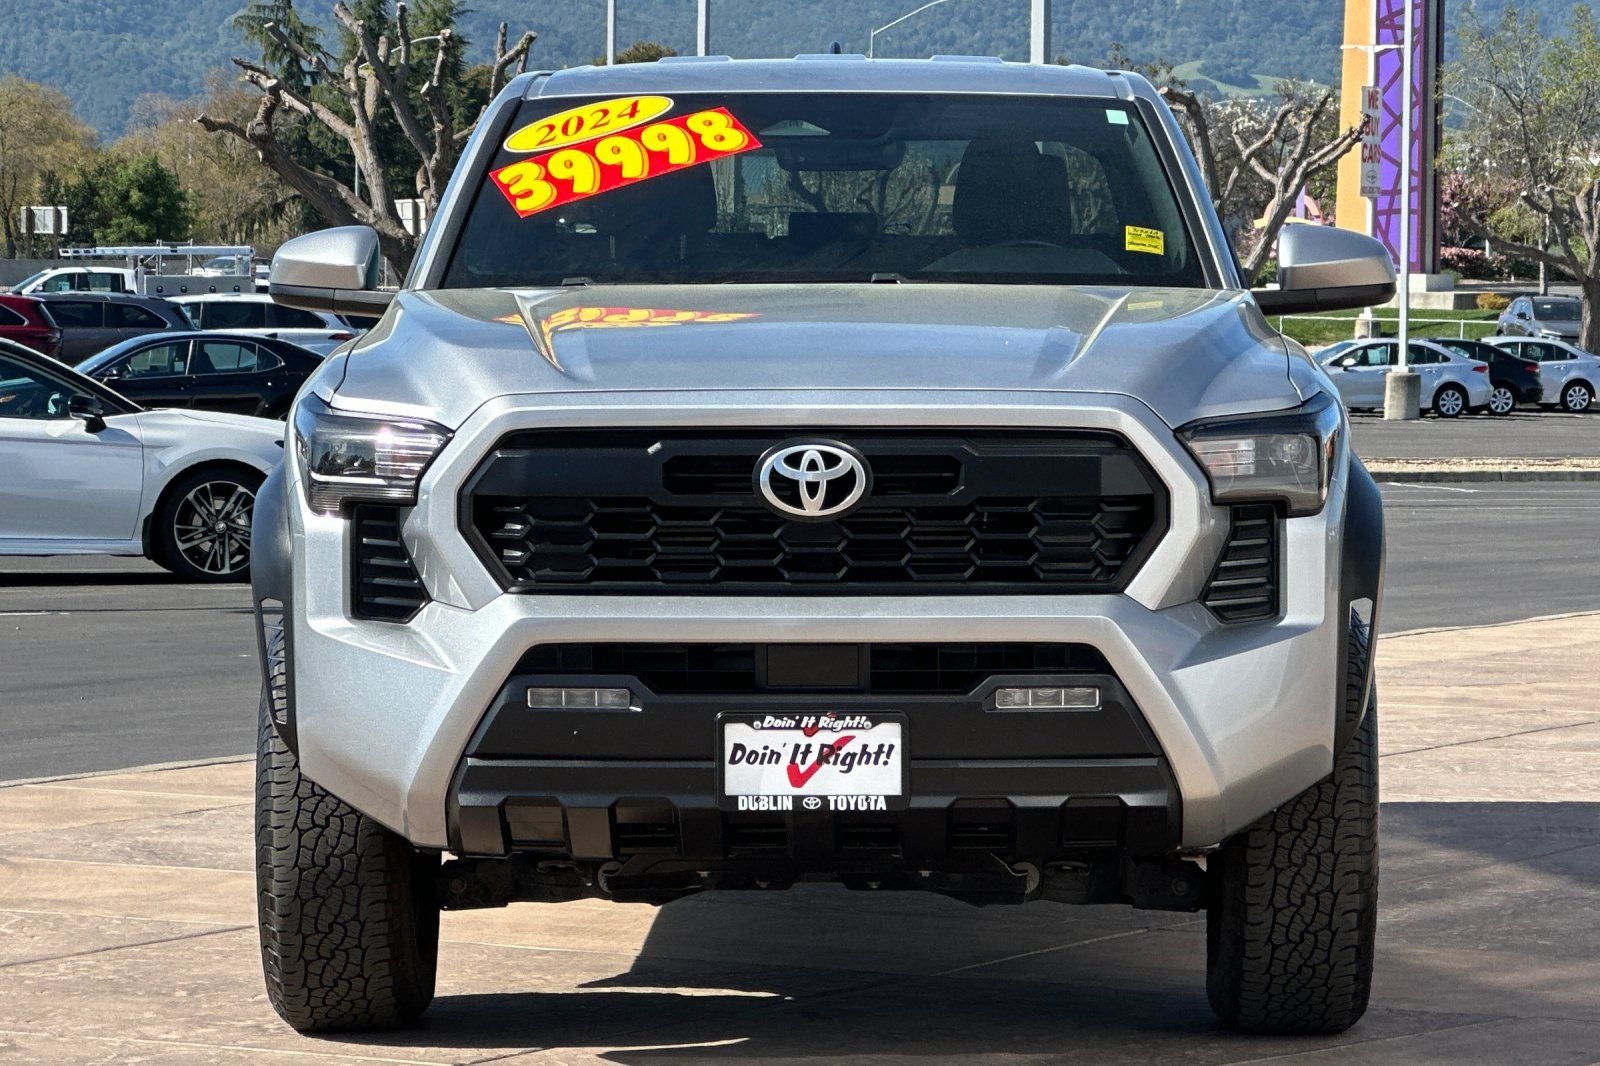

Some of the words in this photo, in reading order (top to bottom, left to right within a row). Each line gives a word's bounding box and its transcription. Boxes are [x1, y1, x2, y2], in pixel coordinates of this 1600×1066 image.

[1367, 89, 1379, 110] WE
[535, 99, 641, 147] 2024
[497, 111, 749, 212] 39998
[1362, 142, 1381, 164] CARS
[763, 715, 799, 728] Doin'
[800, 716, 816, 728] It
[817, 715, 866, 732] Right!
[728, 742, 787, 766] Doin'
[789, 743, 813, 766] It
[816, 743, 896, 774] Right!
[737, 795, 793, 811] DUBLIN
[827, 795, 887, 811] TOYOTA
